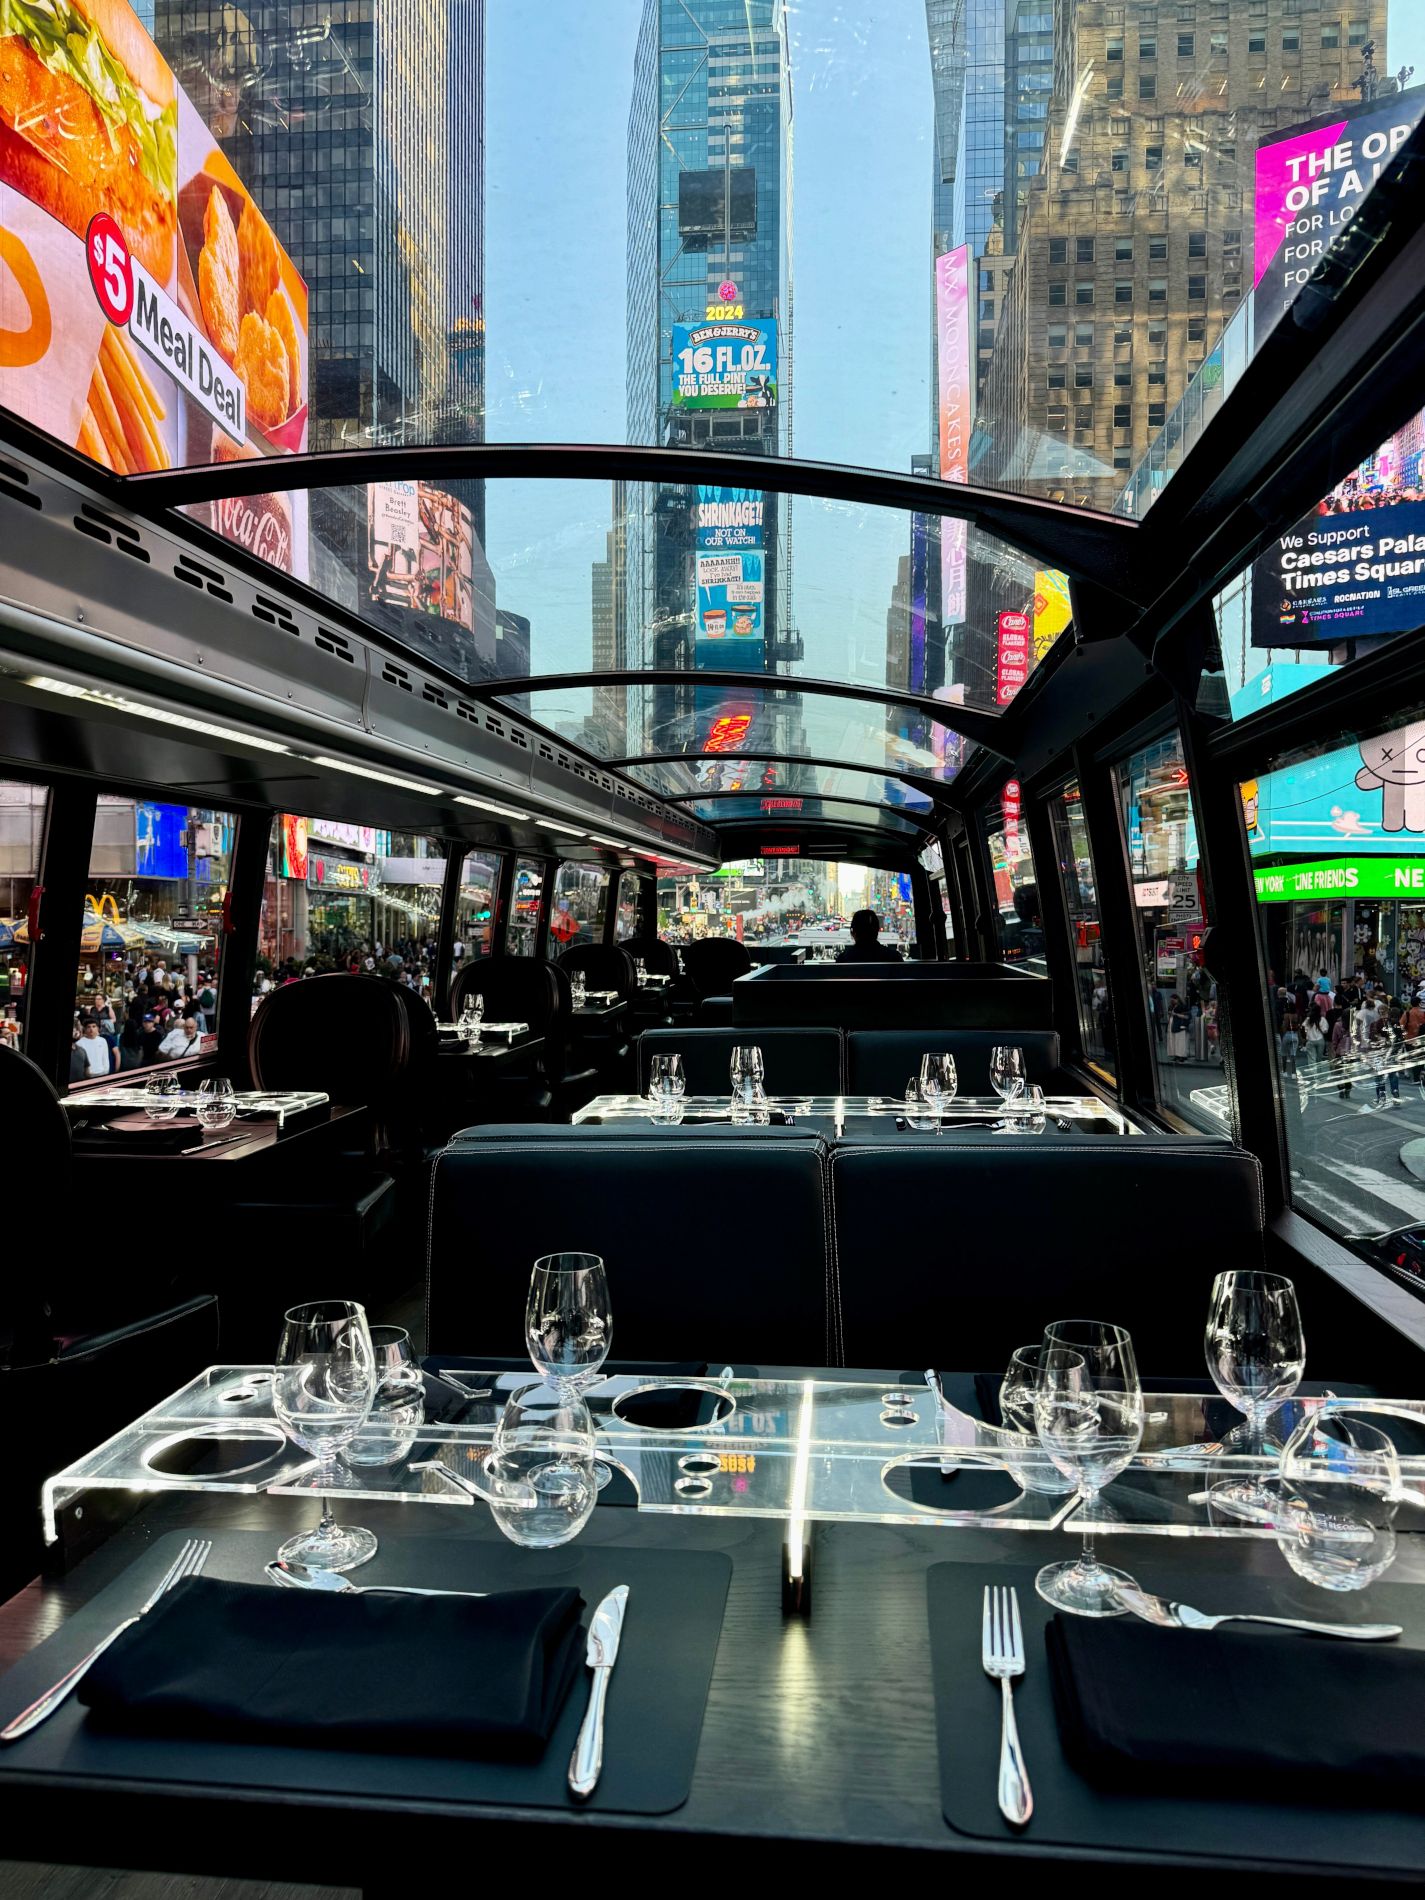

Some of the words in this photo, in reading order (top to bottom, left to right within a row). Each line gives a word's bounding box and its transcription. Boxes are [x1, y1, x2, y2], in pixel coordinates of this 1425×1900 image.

[1286, 141, 1352, 182] THE
[1362, 120, 1420, 159] OP
[1286, 179, 1330, 211] OF
[1338, 169, 1363, 199] A
[1286, 215, 1323, 238] FOR
[1330, 206, 1359, 224] LO
[1285, 239, 1322, 263] FOR
[944, 256, 959, 296] MX
[706, 305, 744, 320] 2024
[92, 233, 128, 314] $5
[136, 279, 194, 384] Meal
[199, 351, 242, 432] Deal
[678, 347, 713, 374] 16
[678, 385, 698, 396] YOU
[701, 383, 746, 396] DESERVE!
[679, 374, 696, 384] THE
[698, 374, 722, 384] FULL
[724, 372, 746, 384] PINT
[945, 305, 962, 460] MOONCAKES
[385, 503, 411, 518] Beasley
[389, 497, 407, 508] Brett
[698, 501, 763, 528] SHRINKAGE?!
[705, 538, 724, 546] OUR
[726, 536, 756, 546] WATCH!
[714, 528, 732, 538] NOT
[734, 528, 746, 537] ON
[1280, 535, 1303, 550] We
[1307, 524, 1370, 546] Support
[1280, 544, 1374, 570] Caesars
[1282, 569, 1351, 590] Times
[1354, 558, 1425, 583] Squar
[1264, 876, 1284, 892] YORK
[1296, 872, 1314, 890] LINE
[1314, 868, 1358, 889] FRIENDS
[1172, 894, 1196, 908] 25
